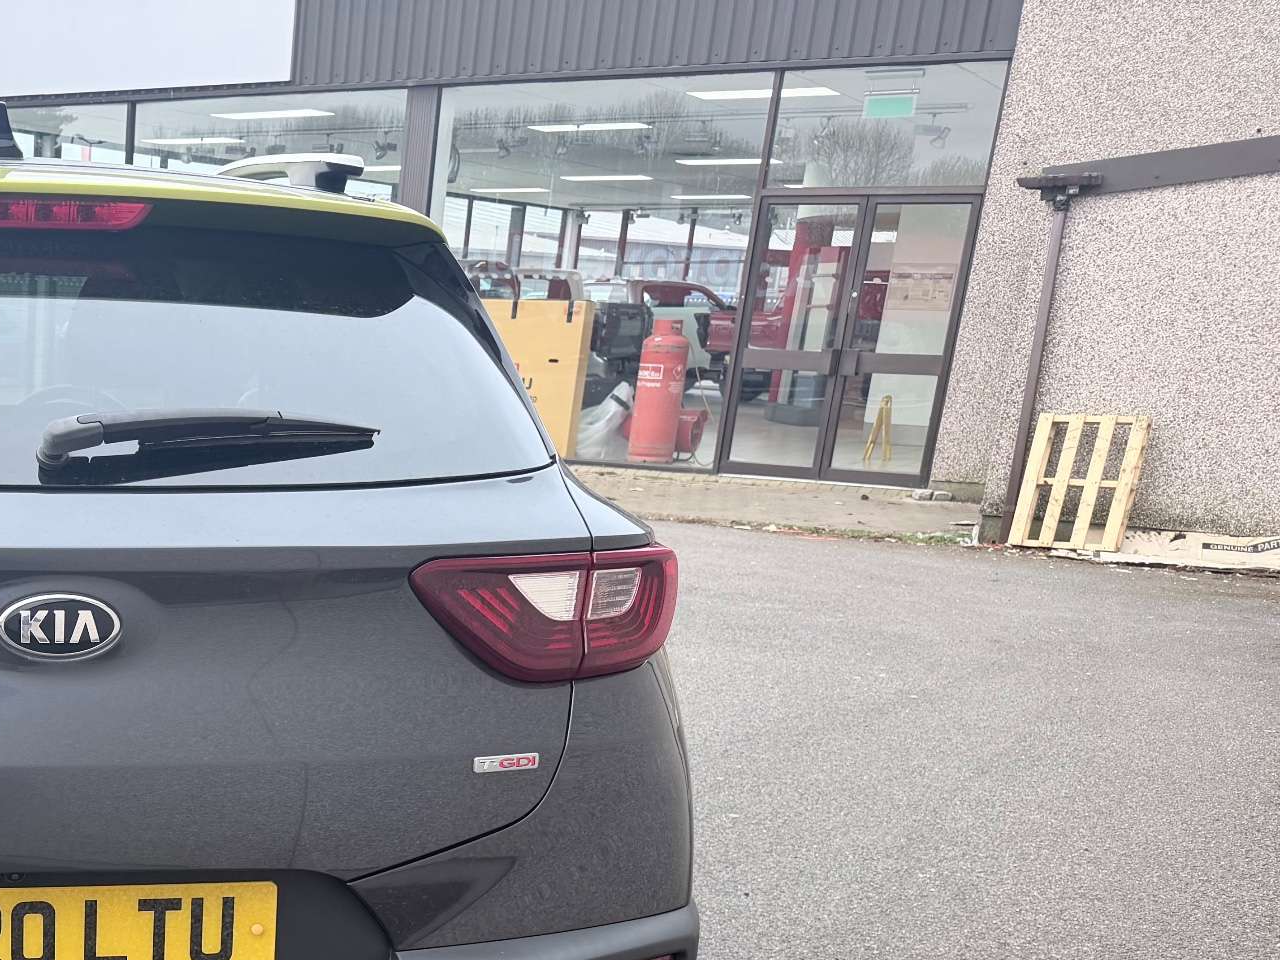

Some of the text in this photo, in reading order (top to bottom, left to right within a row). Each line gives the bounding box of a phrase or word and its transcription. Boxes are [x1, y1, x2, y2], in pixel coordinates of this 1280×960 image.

[1210, 541, 1280, 553] GENUINE PAR
[20, 609, 100, 643] KIA
